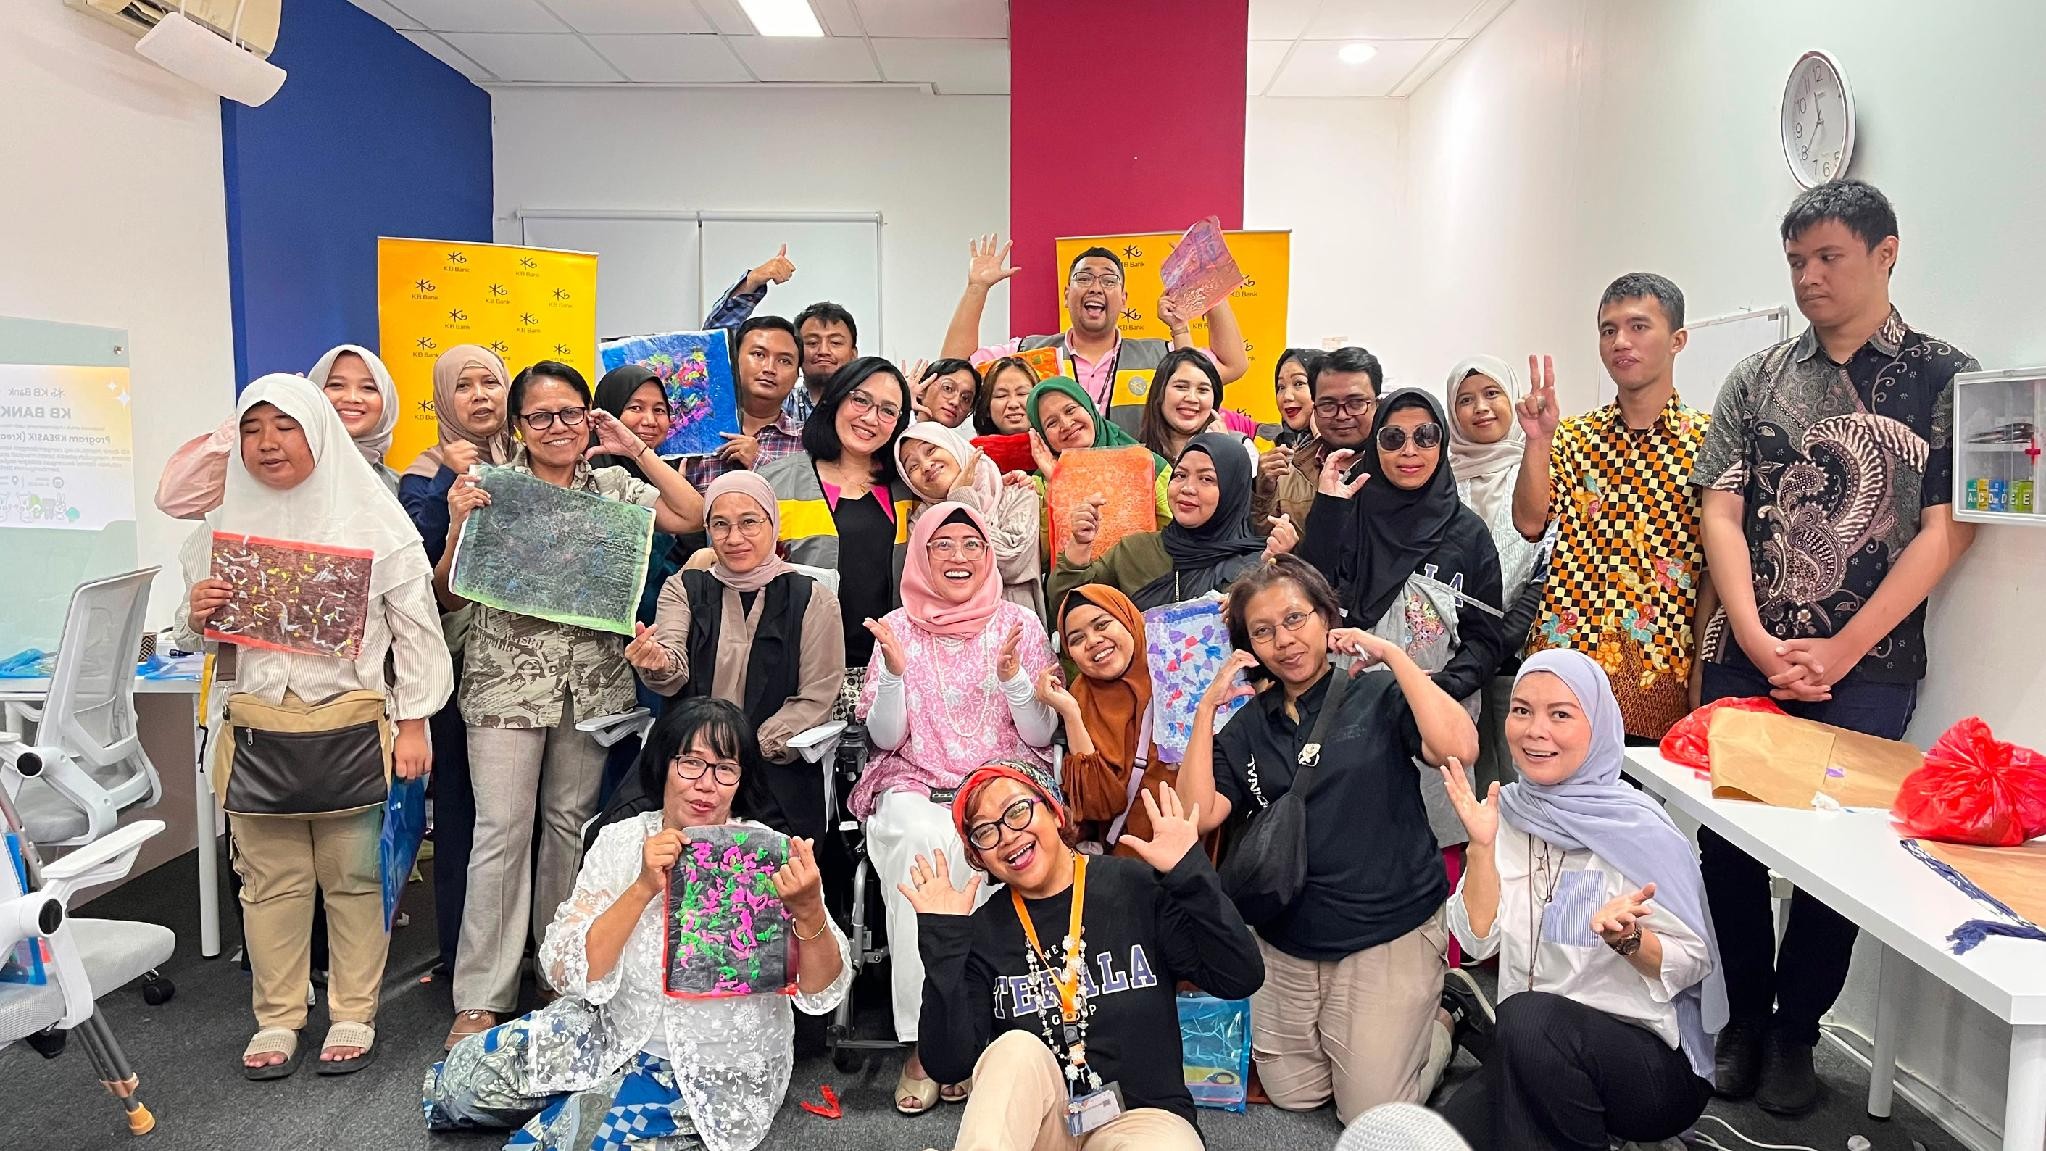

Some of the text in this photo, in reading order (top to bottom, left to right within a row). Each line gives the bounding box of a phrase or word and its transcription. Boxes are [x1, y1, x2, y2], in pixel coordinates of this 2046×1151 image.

[1812, 65, 1823, 82] 12
[1795, 122, 1803, 139] 9
[1801, 144, 1809, 160] 8
[1812, 159, 1819, 176] 7
[1822, 161, 1831, 178] 6
